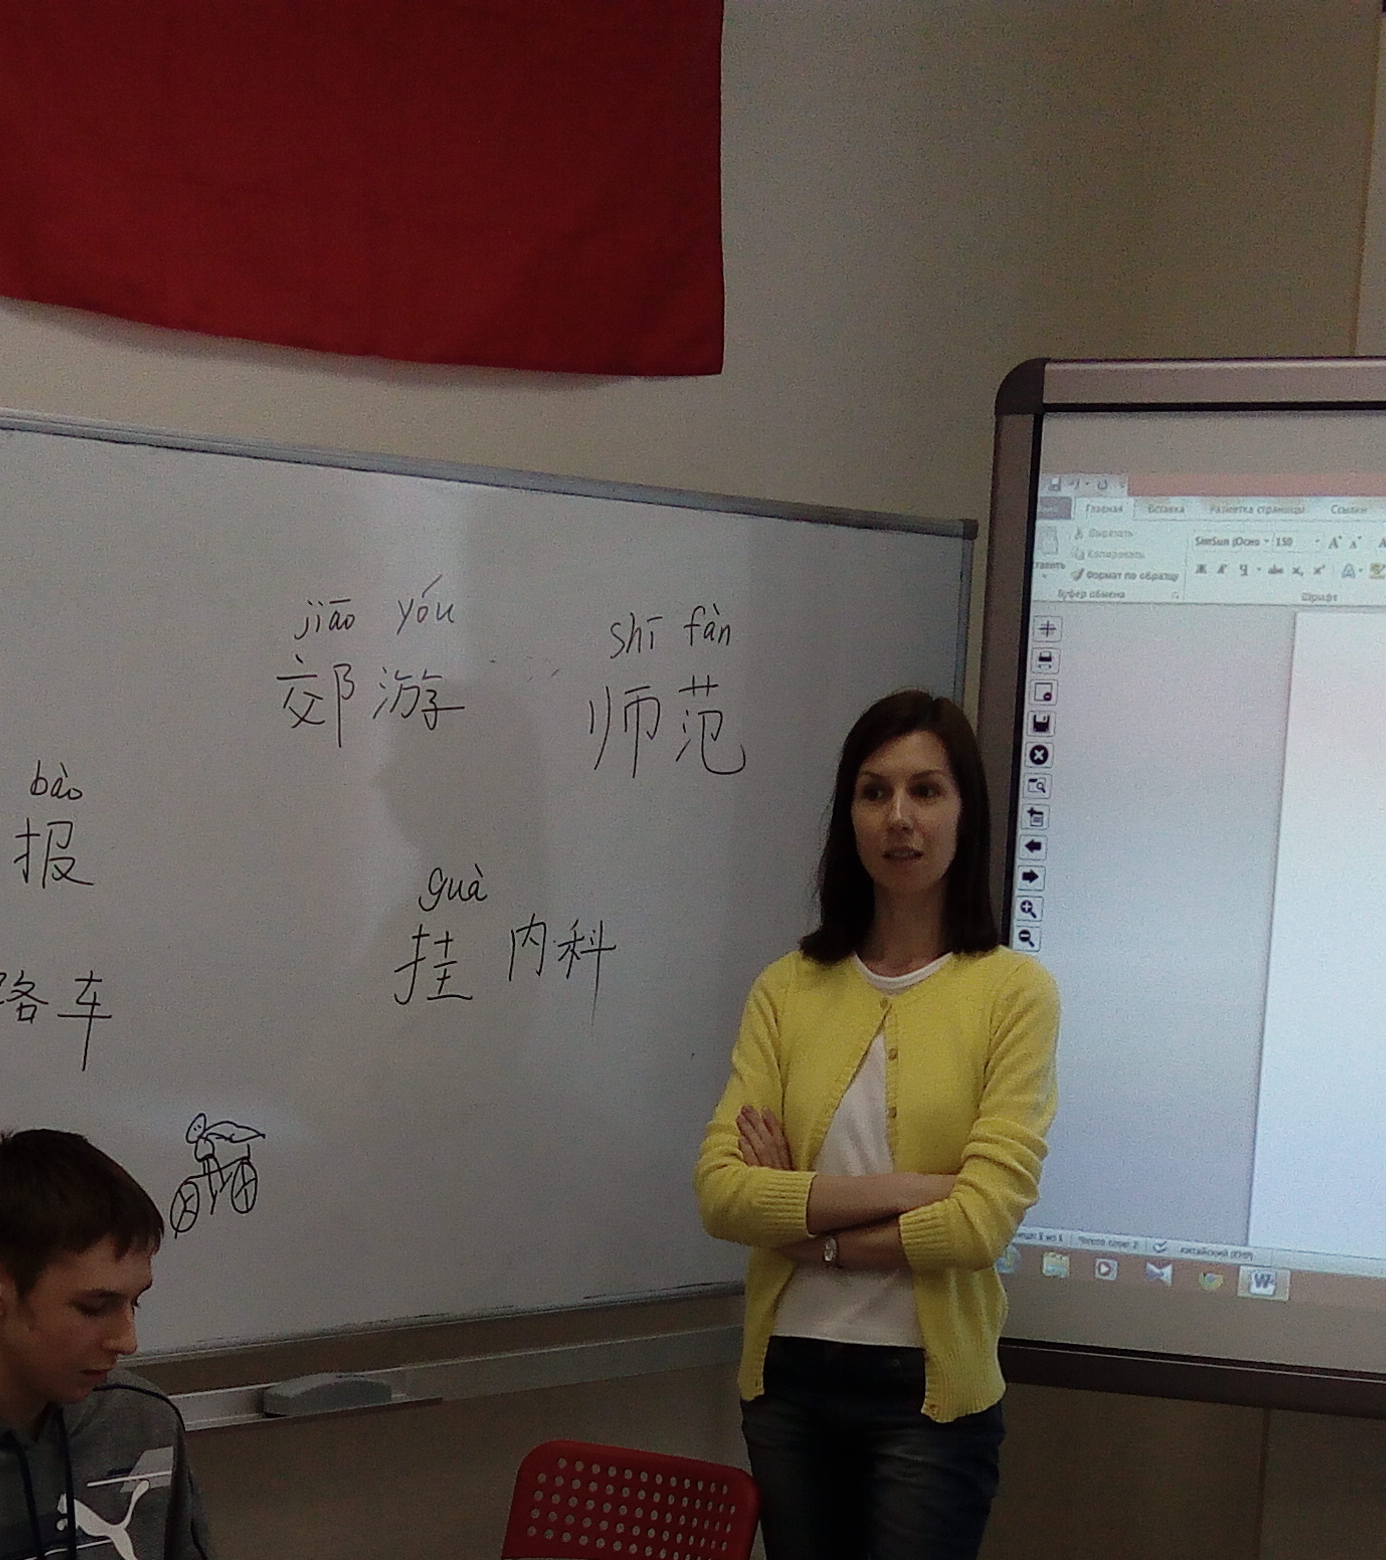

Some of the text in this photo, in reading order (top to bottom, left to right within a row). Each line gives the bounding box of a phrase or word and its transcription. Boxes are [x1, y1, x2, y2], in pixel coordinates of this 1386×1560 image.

[293, 573, 455, 641] jiāo yóu
[609, 611, 664, 660] shī
[276, 653, 466, 749] 郊游
[588, 674, 747, 779] 师范
[29, 759, 84, 801] bào
[417, 862, 488, 913] guà
